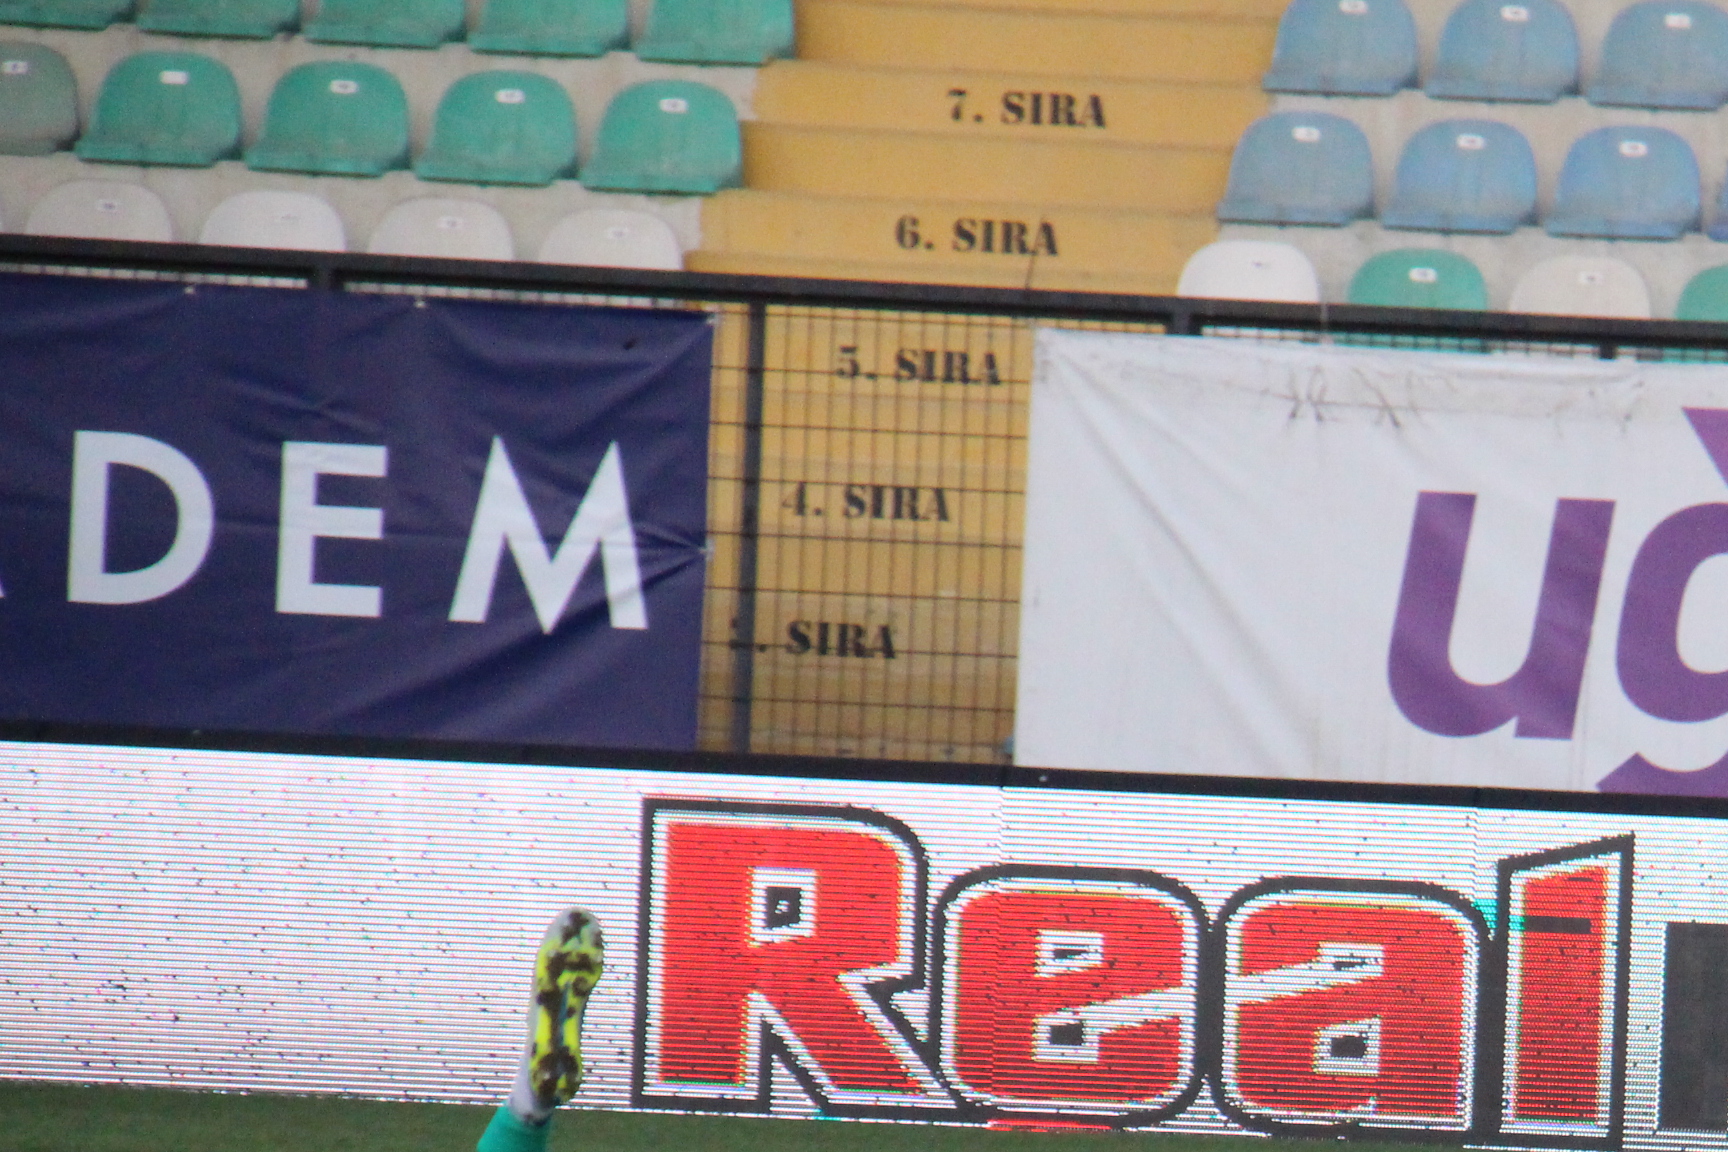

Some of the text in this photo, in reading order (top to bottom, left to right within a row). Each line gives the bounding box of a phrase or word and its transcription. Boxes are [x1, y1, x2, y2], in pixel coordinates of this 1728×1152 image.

[947, 89, 1108, 129] 7. SIRA
[894, 215, 1059, 257] 6. SIRA
[835, 345, 1002, 386] 5. SIRA
[780, 481, 951, 522] 4. SIRA
[0, 430, 648, 635] DEM
[786, 620, 897, 659] SIRA
[631, 797, 1635, 1152] Real
